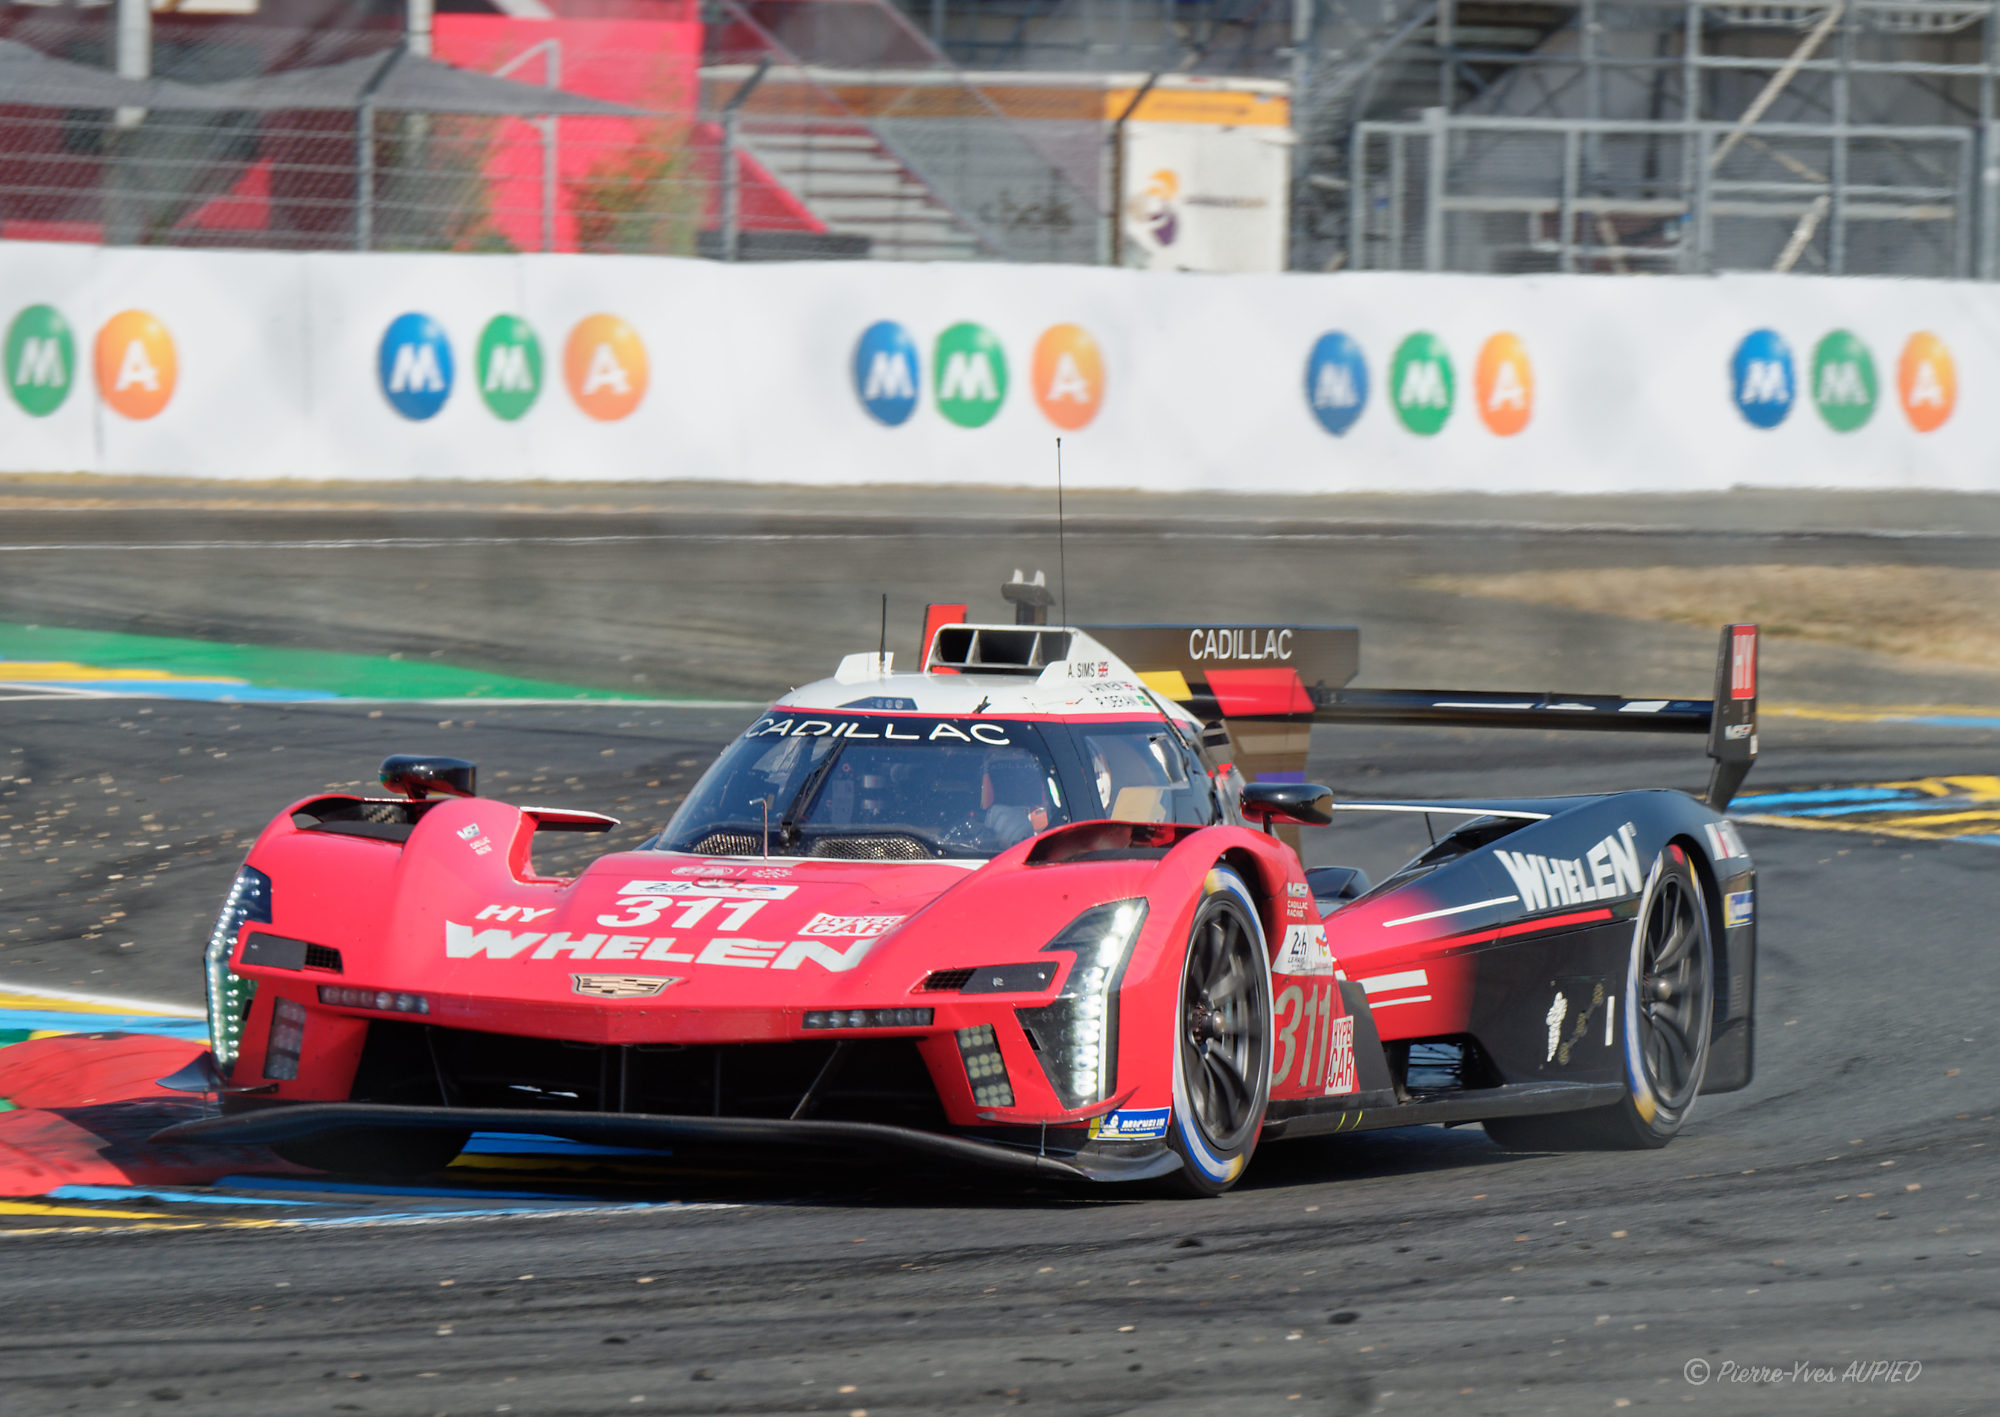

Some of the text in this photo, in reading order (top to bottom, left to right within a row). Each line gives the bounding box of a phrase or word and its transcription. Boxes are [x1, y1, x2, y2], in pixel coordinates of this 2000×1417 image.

[1189, 629, 1293, 660] CADILLAC
[1077, 662, 1095, 678] SIMS
[746, 718, 1010, 746] CADILLAC
[1494, 822, 1642, 912] WHELEN
[475, 904, 557, 923] HY
[597, 895, 769, 932] 311
[806, 923, 884, 934] CAR
[446, 920, 880, 972] WHELEN
[1271, 984, 1332, 1087] 311
[1328, 1047, 1353, 1089] CAR
